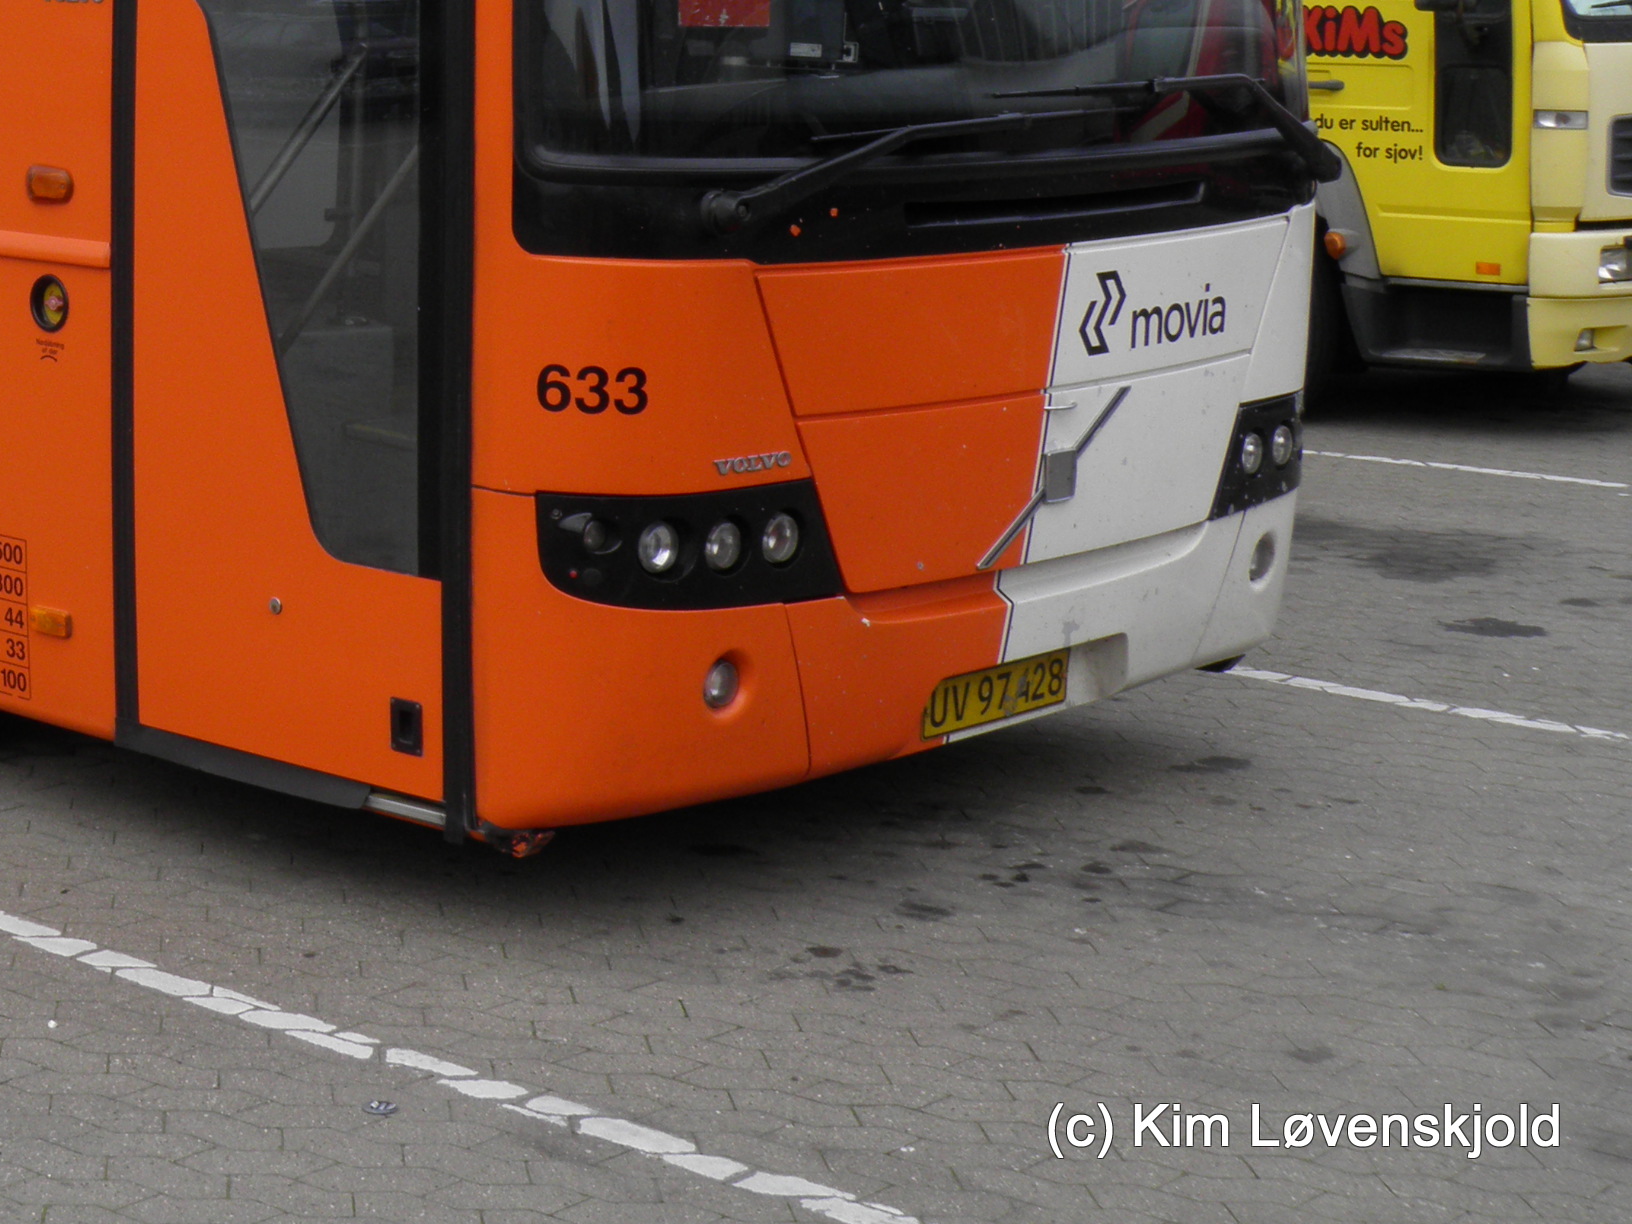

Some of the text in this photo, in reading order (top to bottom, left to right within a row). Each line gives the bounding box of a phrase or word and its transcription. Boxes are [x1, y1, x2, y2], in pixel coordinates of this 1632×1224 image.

[1314, 114, 1424, 133] du er sulten...
[1356, 142, 1423, 163] for sjov!
[1130, 283, 1226, 349] movia
[536, 364, 648, 415] 633
[713, 451, 792, 475] VOLVO
[4, 607, 24, 628] 44
[6, 638, 25, 660] 33
[1, 669, 27, 692] 100
[930, 658, 1064, 728] UV 97 428
